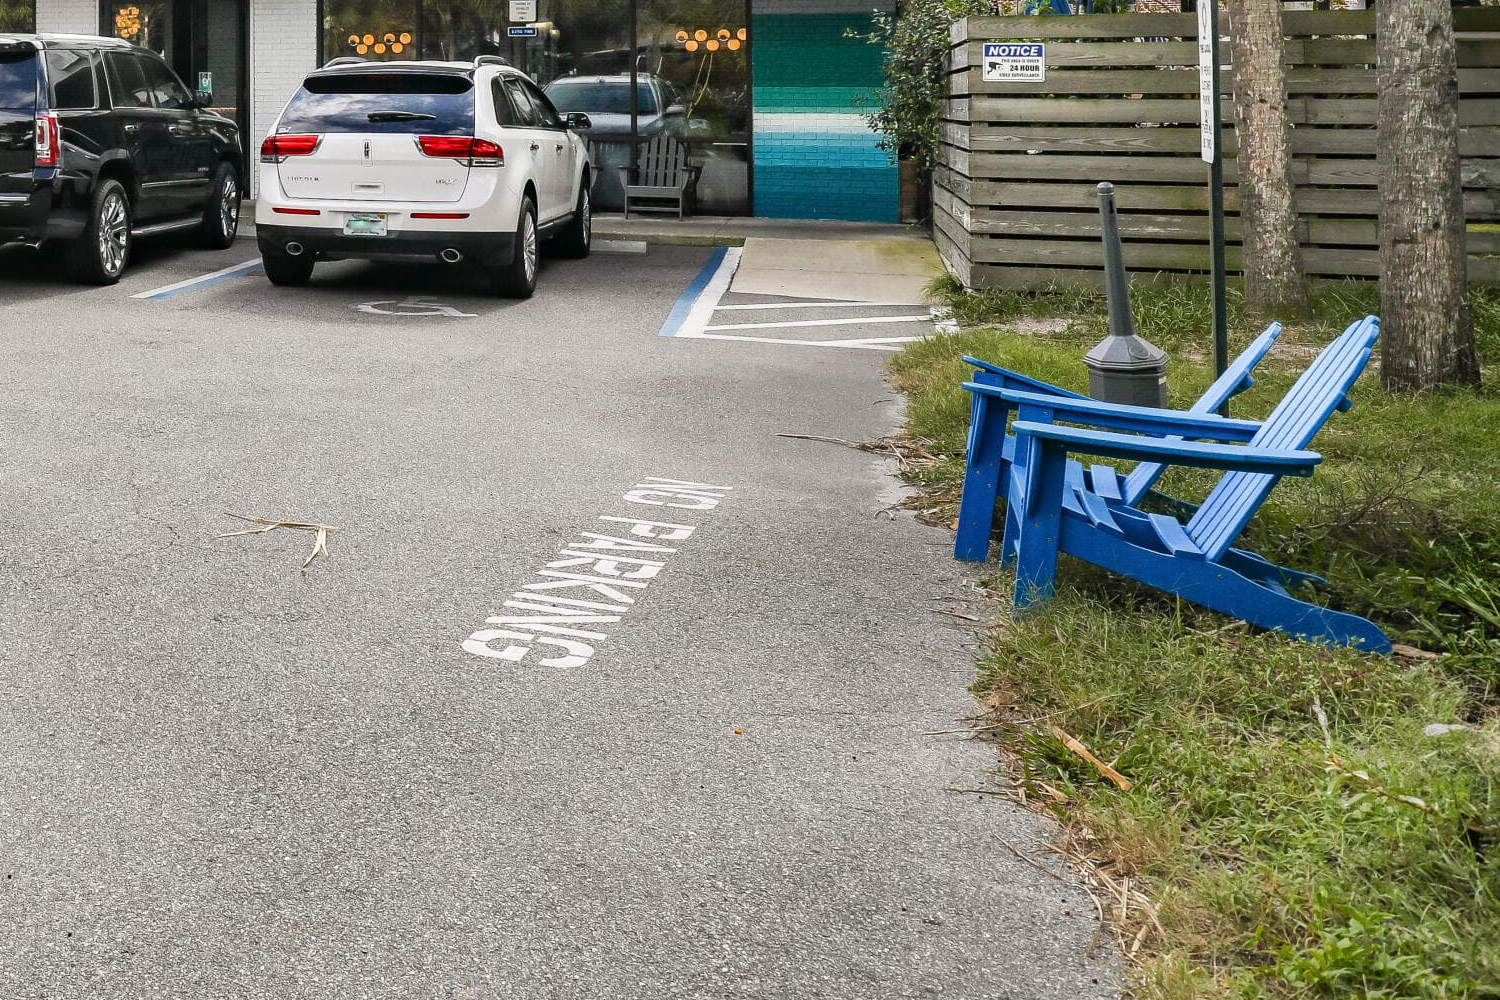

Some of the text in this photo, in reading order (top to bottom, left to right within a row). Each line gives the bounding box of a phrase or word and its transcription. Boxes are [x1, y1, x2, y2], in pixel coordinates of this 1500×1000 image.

[988, 46, 1039, 56] NOTICE
[460, 476, 733, 668] NO PARKING
